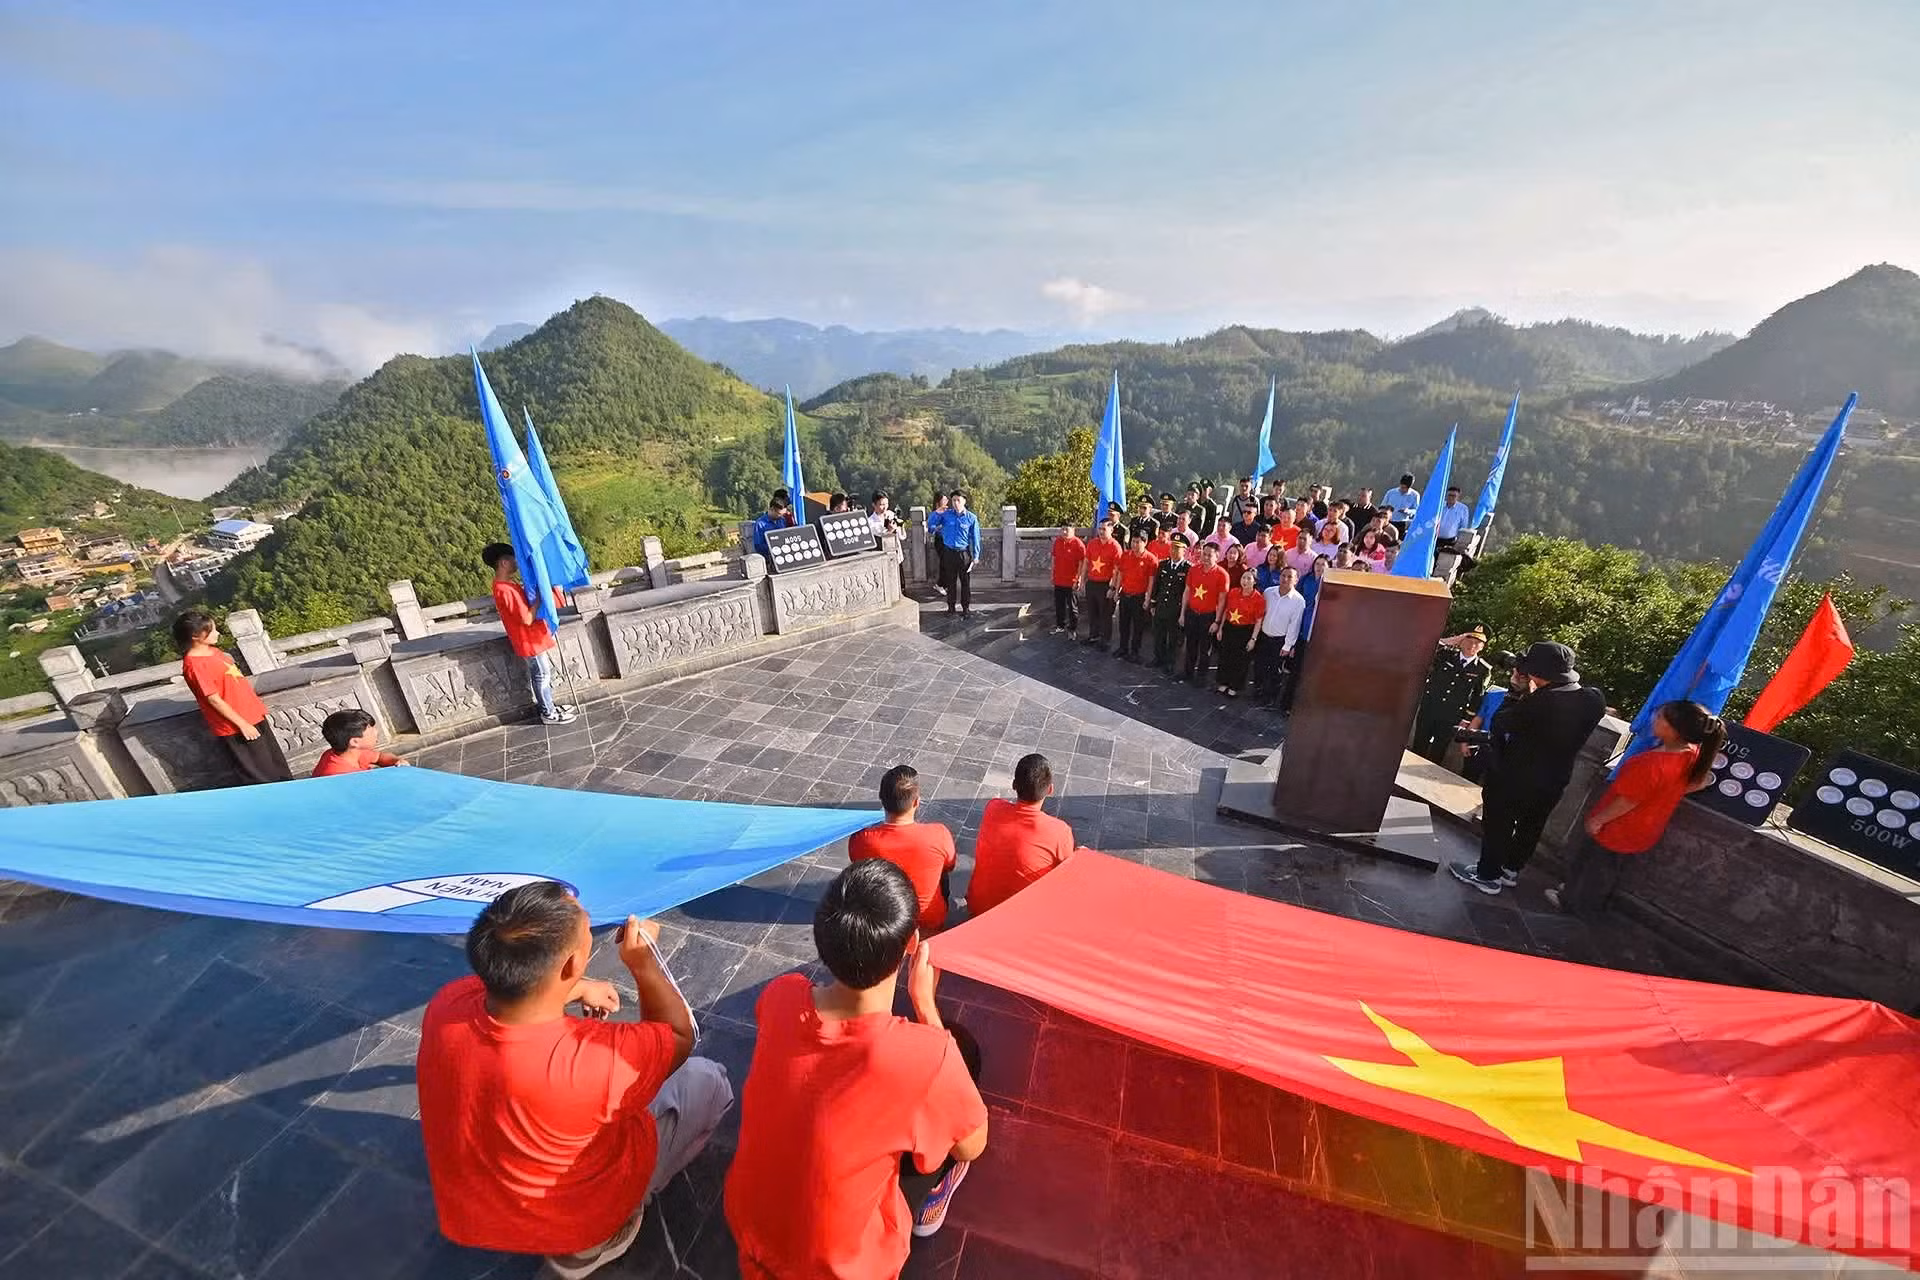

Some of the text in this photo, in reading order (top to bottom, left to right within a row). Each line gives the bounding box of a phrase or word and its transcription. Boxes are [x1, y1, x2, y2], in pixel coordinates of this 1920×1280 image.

[842, 536, 860, 545] 500W
[1850, 818, 1913, 849] 500W
[461, 876, 512, 889] NAM
